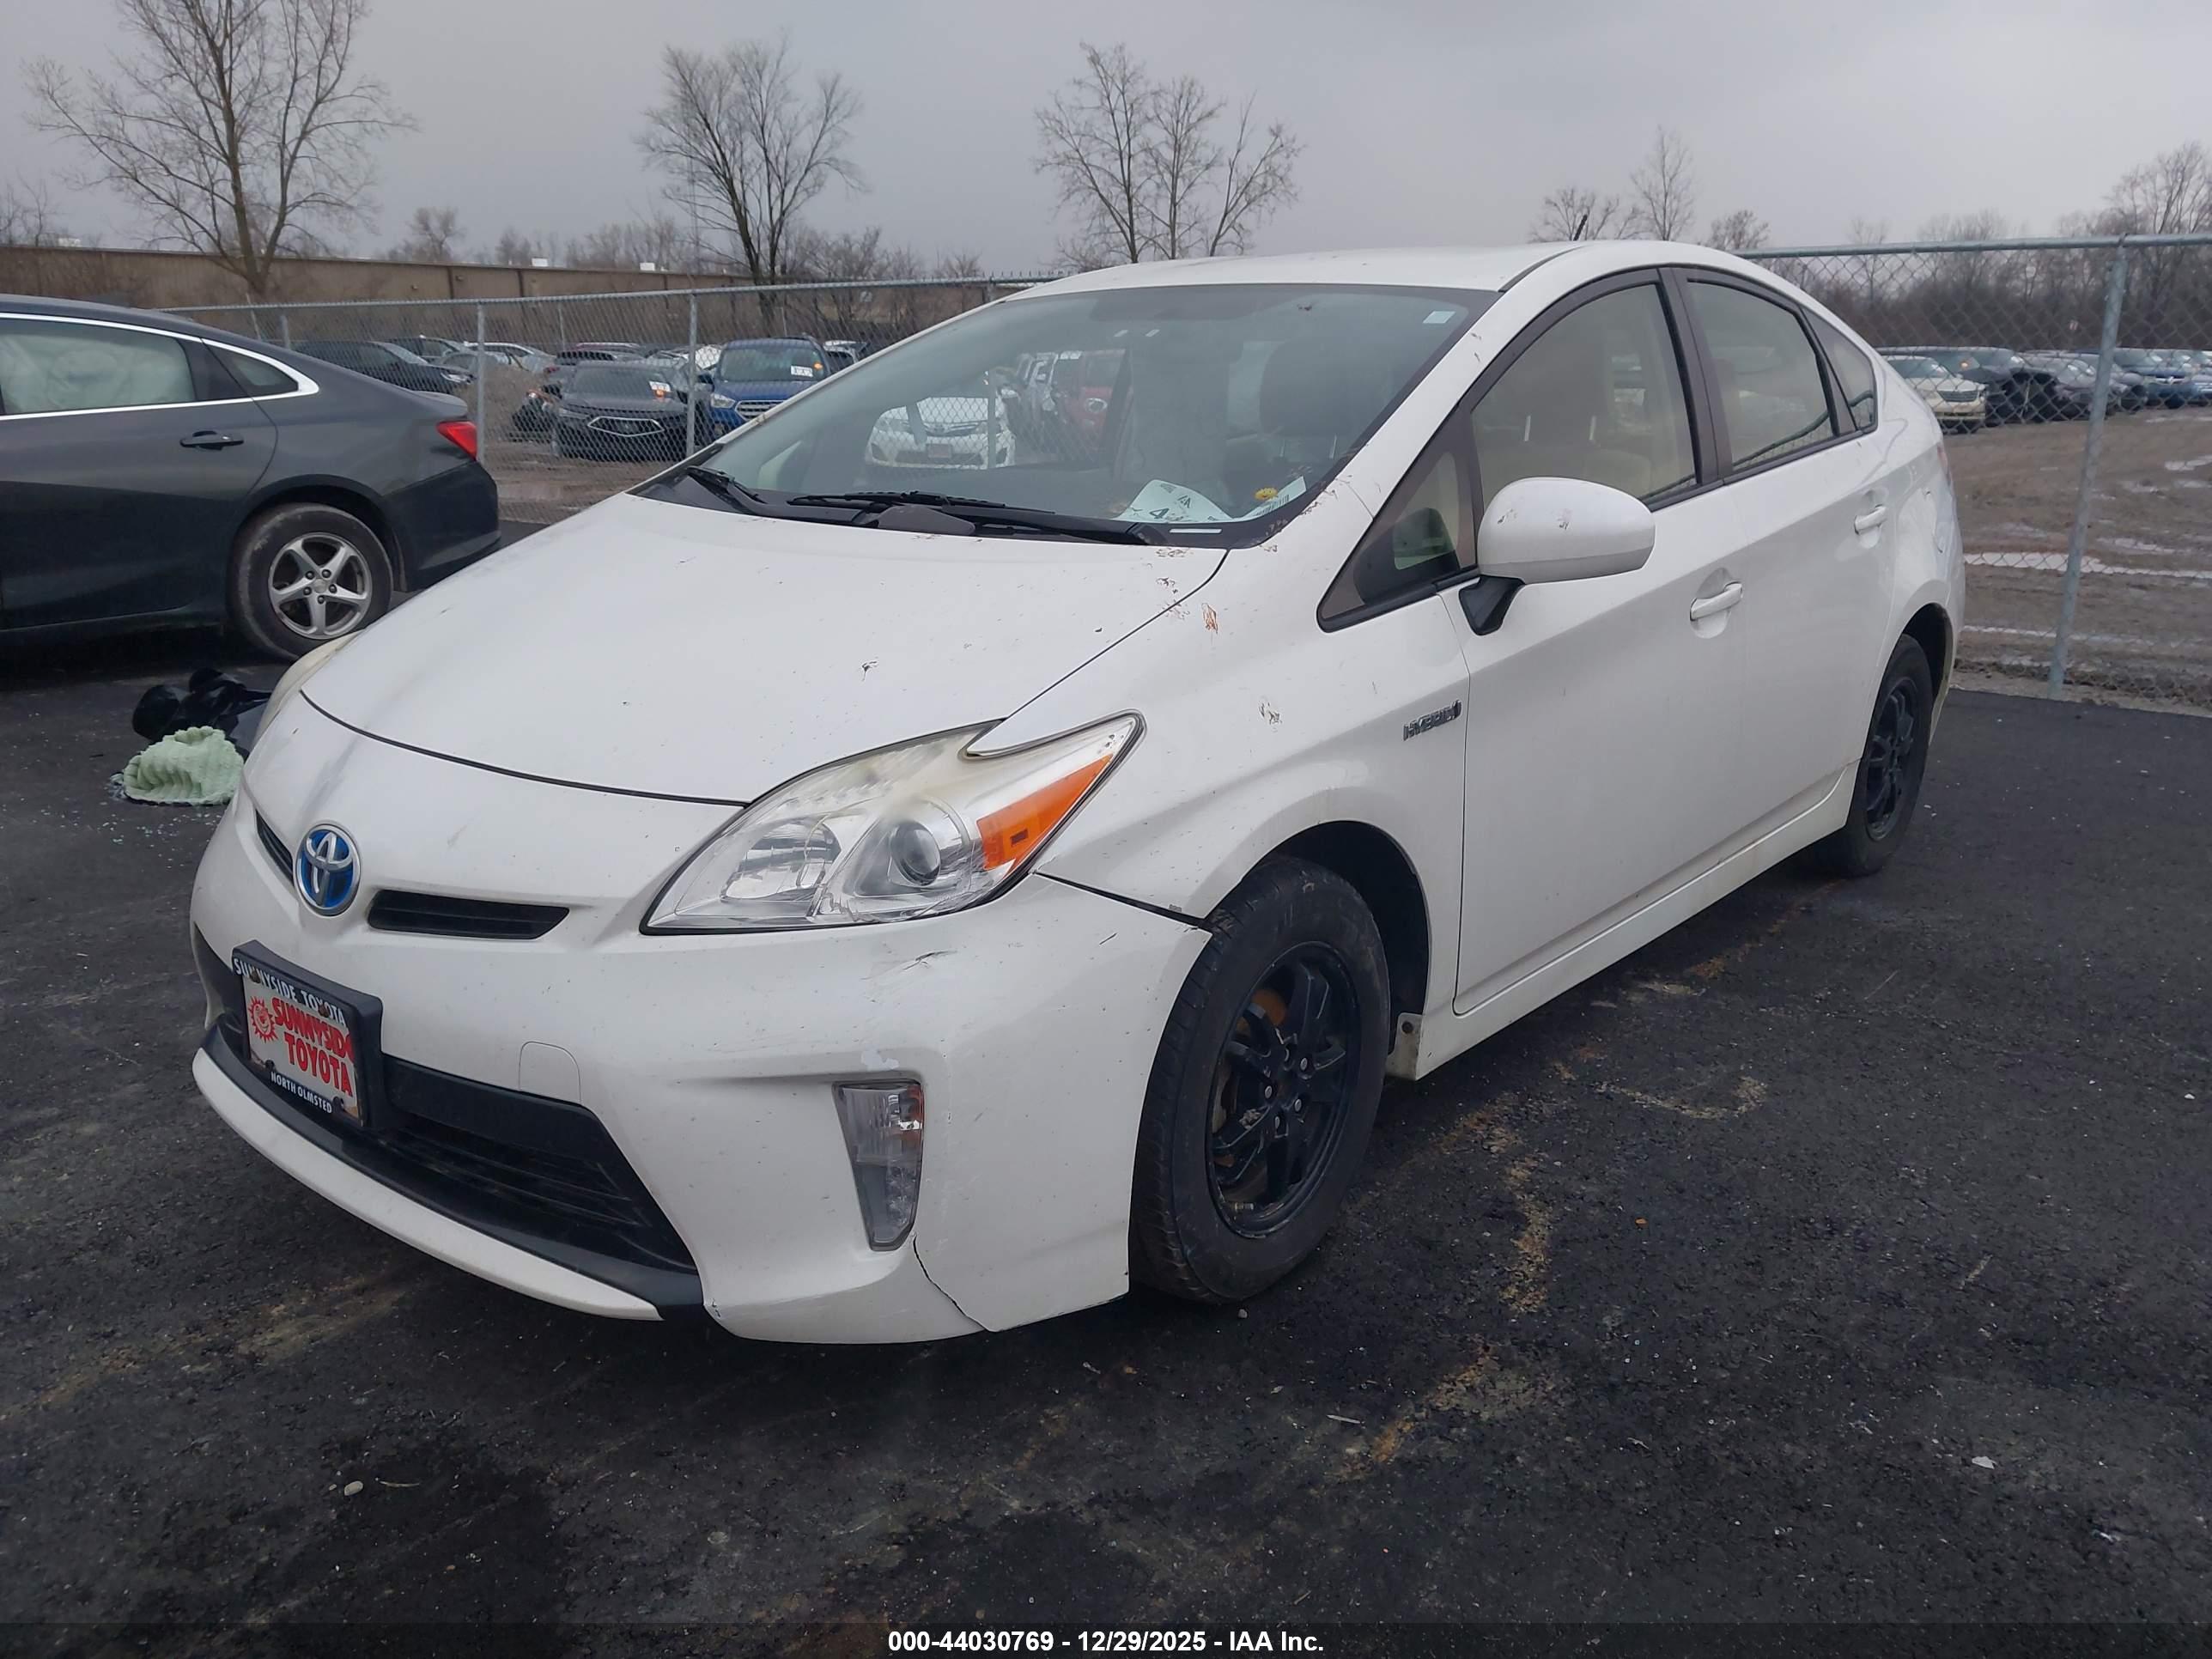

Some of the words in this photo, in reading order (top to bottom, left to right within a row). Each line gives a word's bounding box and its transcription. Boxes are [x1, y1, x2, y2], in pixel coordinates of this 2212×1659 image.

[284, 1031, 354, 1097] TOYOTA
[270, 1071, 297, 1094] NORTH
[297, 1086, 332, 1114] OLMSTED
